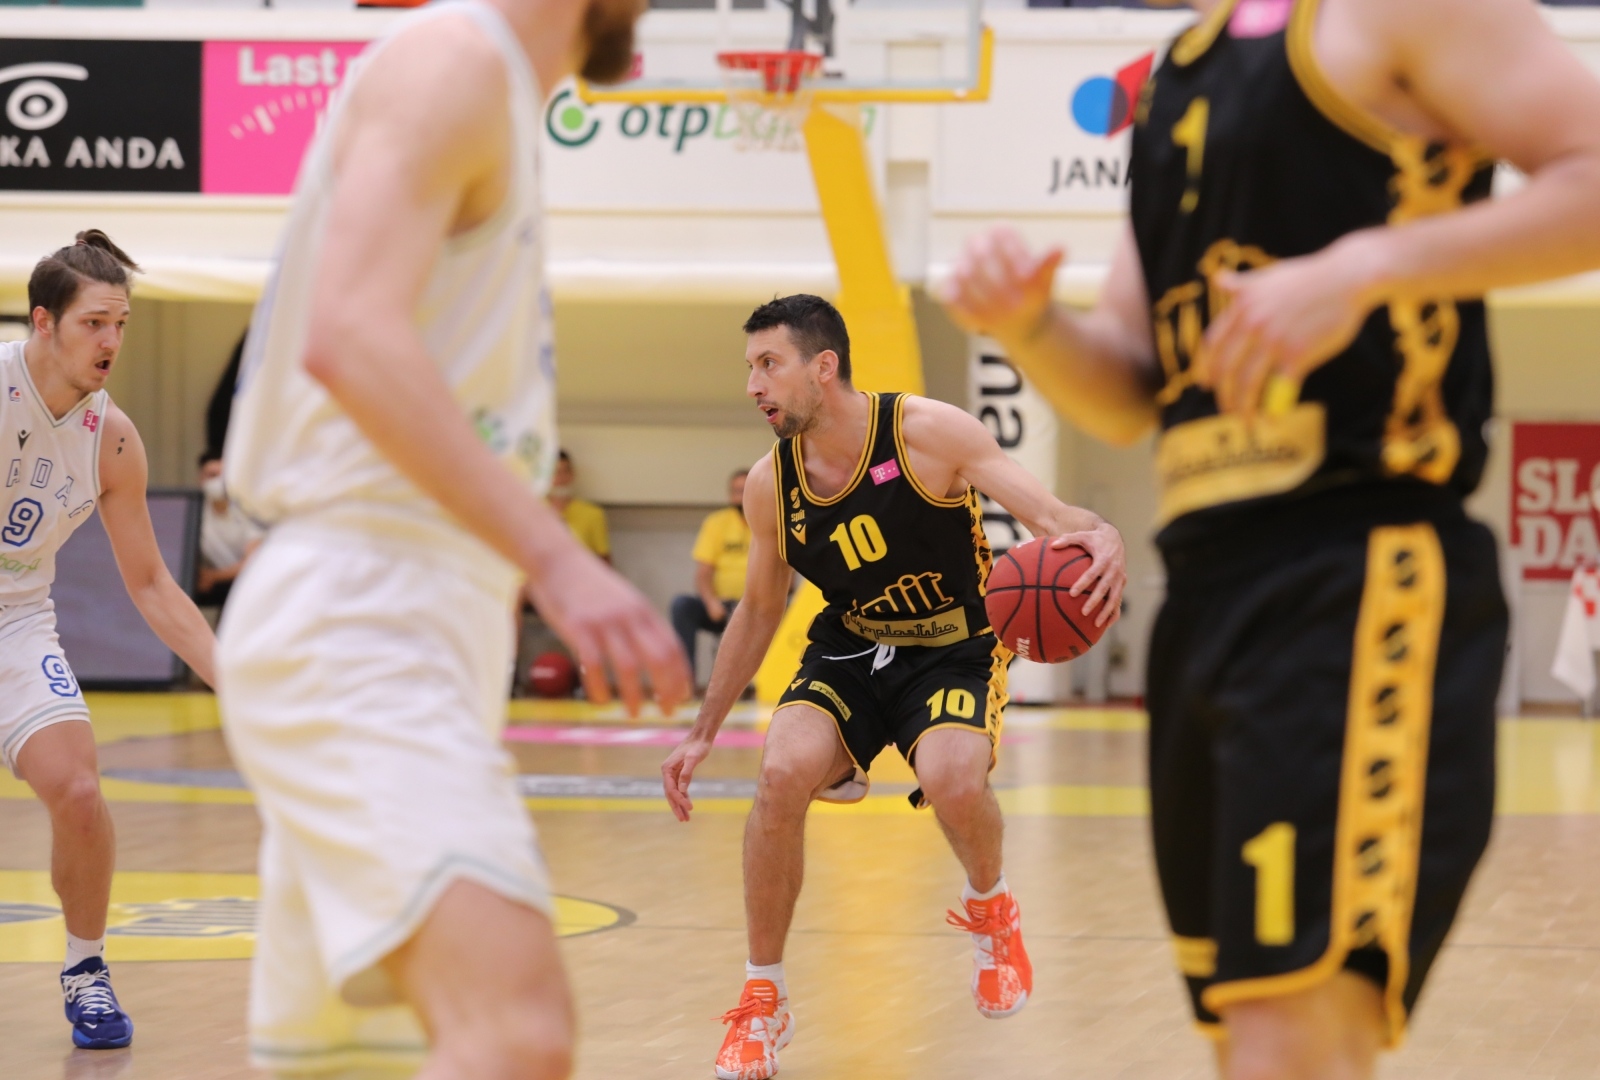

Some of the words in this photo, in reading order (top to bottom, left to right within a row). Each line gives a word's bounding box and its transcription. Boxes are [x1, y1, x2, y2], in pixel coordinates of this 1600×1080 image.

[237, 46, 340, 88] Last
[64, 135, 185, 170] ANDA
[1, 497, 44, 548] 9
[790, 509, 806, 523] split
[828, 514, 888, 572] 10
[41, 654, 79, 698] 9
[926, 687, 976, 722] 10
[1242, 822, 1297, 946] 1
